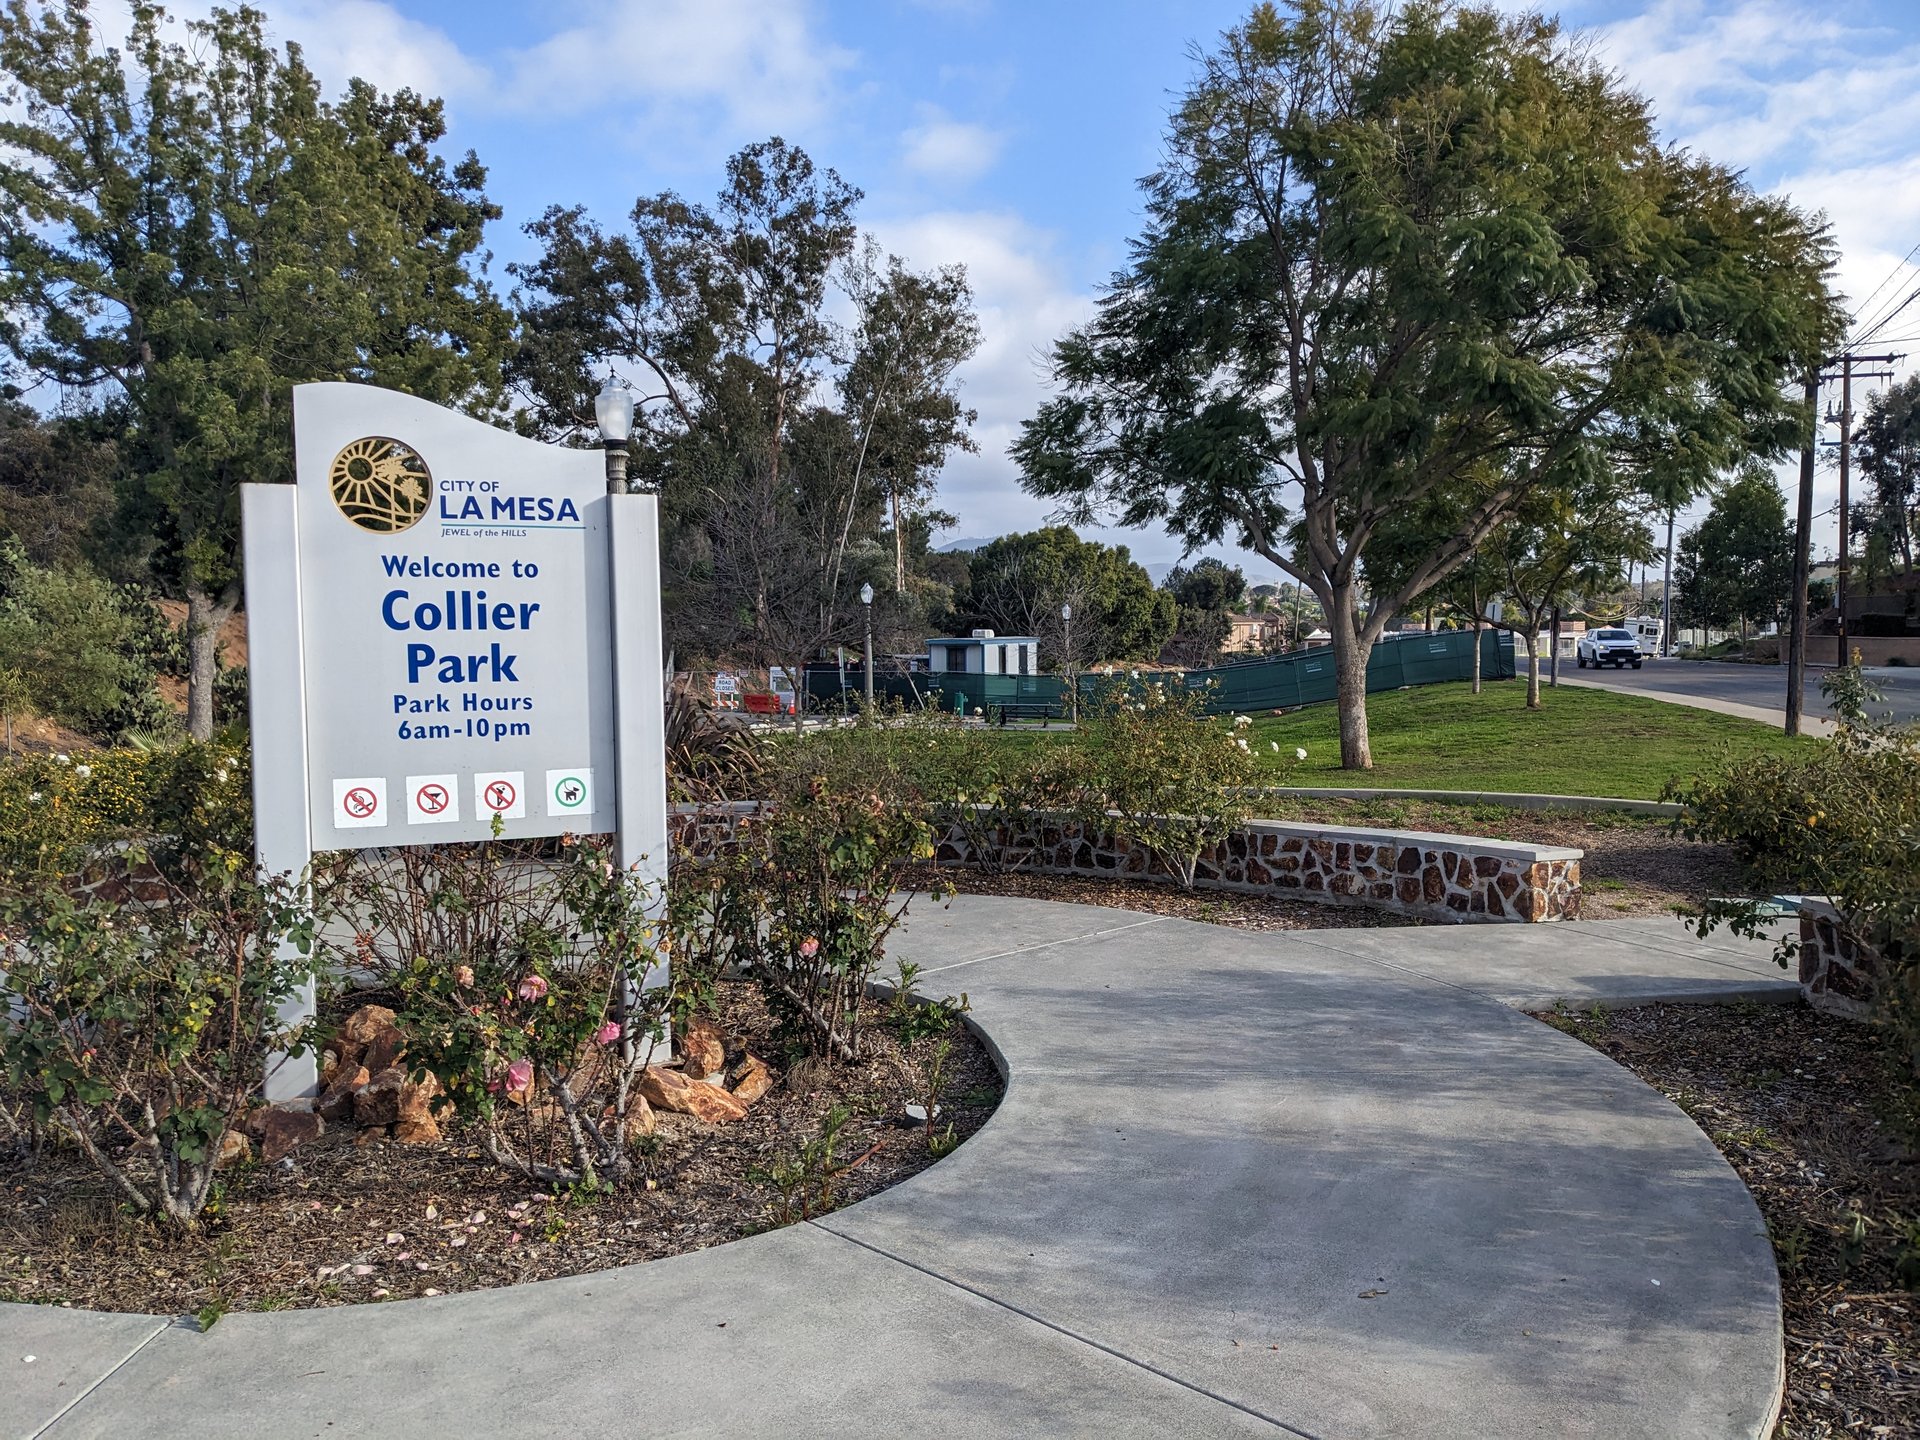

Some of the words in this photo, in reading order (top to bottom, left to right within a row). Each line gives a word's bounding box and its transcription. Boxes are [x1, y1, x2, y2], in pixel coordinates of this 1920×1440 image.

[440, 481, 475, 492] CITY
[480, 481, 499, 492] OF
[440, 495, 484, 520] LA
[491, 496, 580, 521] MESA
[441, 528, 471, 538] JEWEL
[474, 528, 484, 538] of
[484, 528, 499, 537] the
[501, 529, 527, 538] HILLS
[381, 555, 500, 578] Welcome
[512, 559, 539, 579] to
[382, 589, 541, 631] Collier
[407, 643, 520, 684] Park
[394, 694, 451, 714] Park
[463, 693, 533, 711] Hours
[398, 718, 531, 742] 6am-10pm
